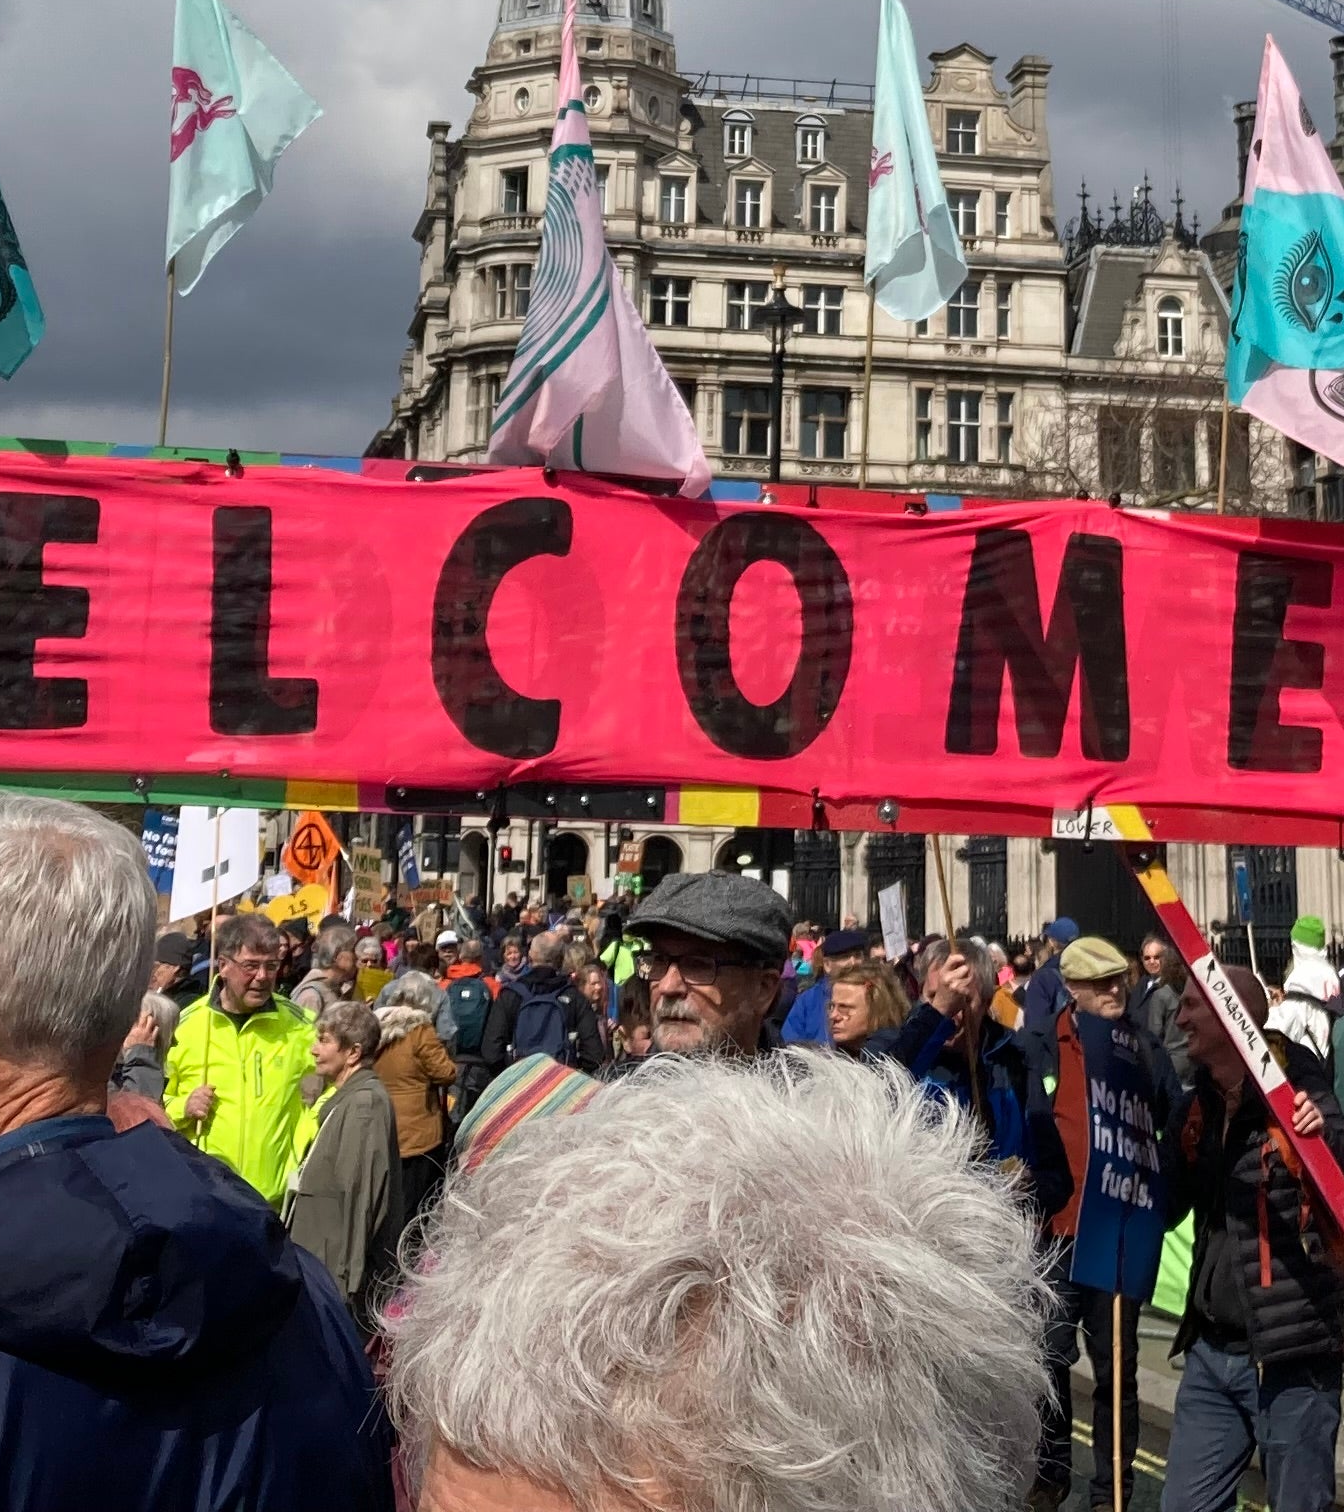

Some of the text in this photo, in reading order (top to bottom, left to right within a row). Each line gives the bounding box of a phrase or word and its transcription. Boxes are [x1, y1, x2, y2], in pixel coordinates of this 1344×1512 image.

[141, 829, 160, 843] No
[1056, 819, 1113, 835] LOWER
[1212, 981, 1258, 1051] DIAGONAL
[1090, 1078, 1155, 1136] No faith
[1093, 1113, 1161, 1175] in fossil
[1100, 1161, 1154, 1211] fuels.
